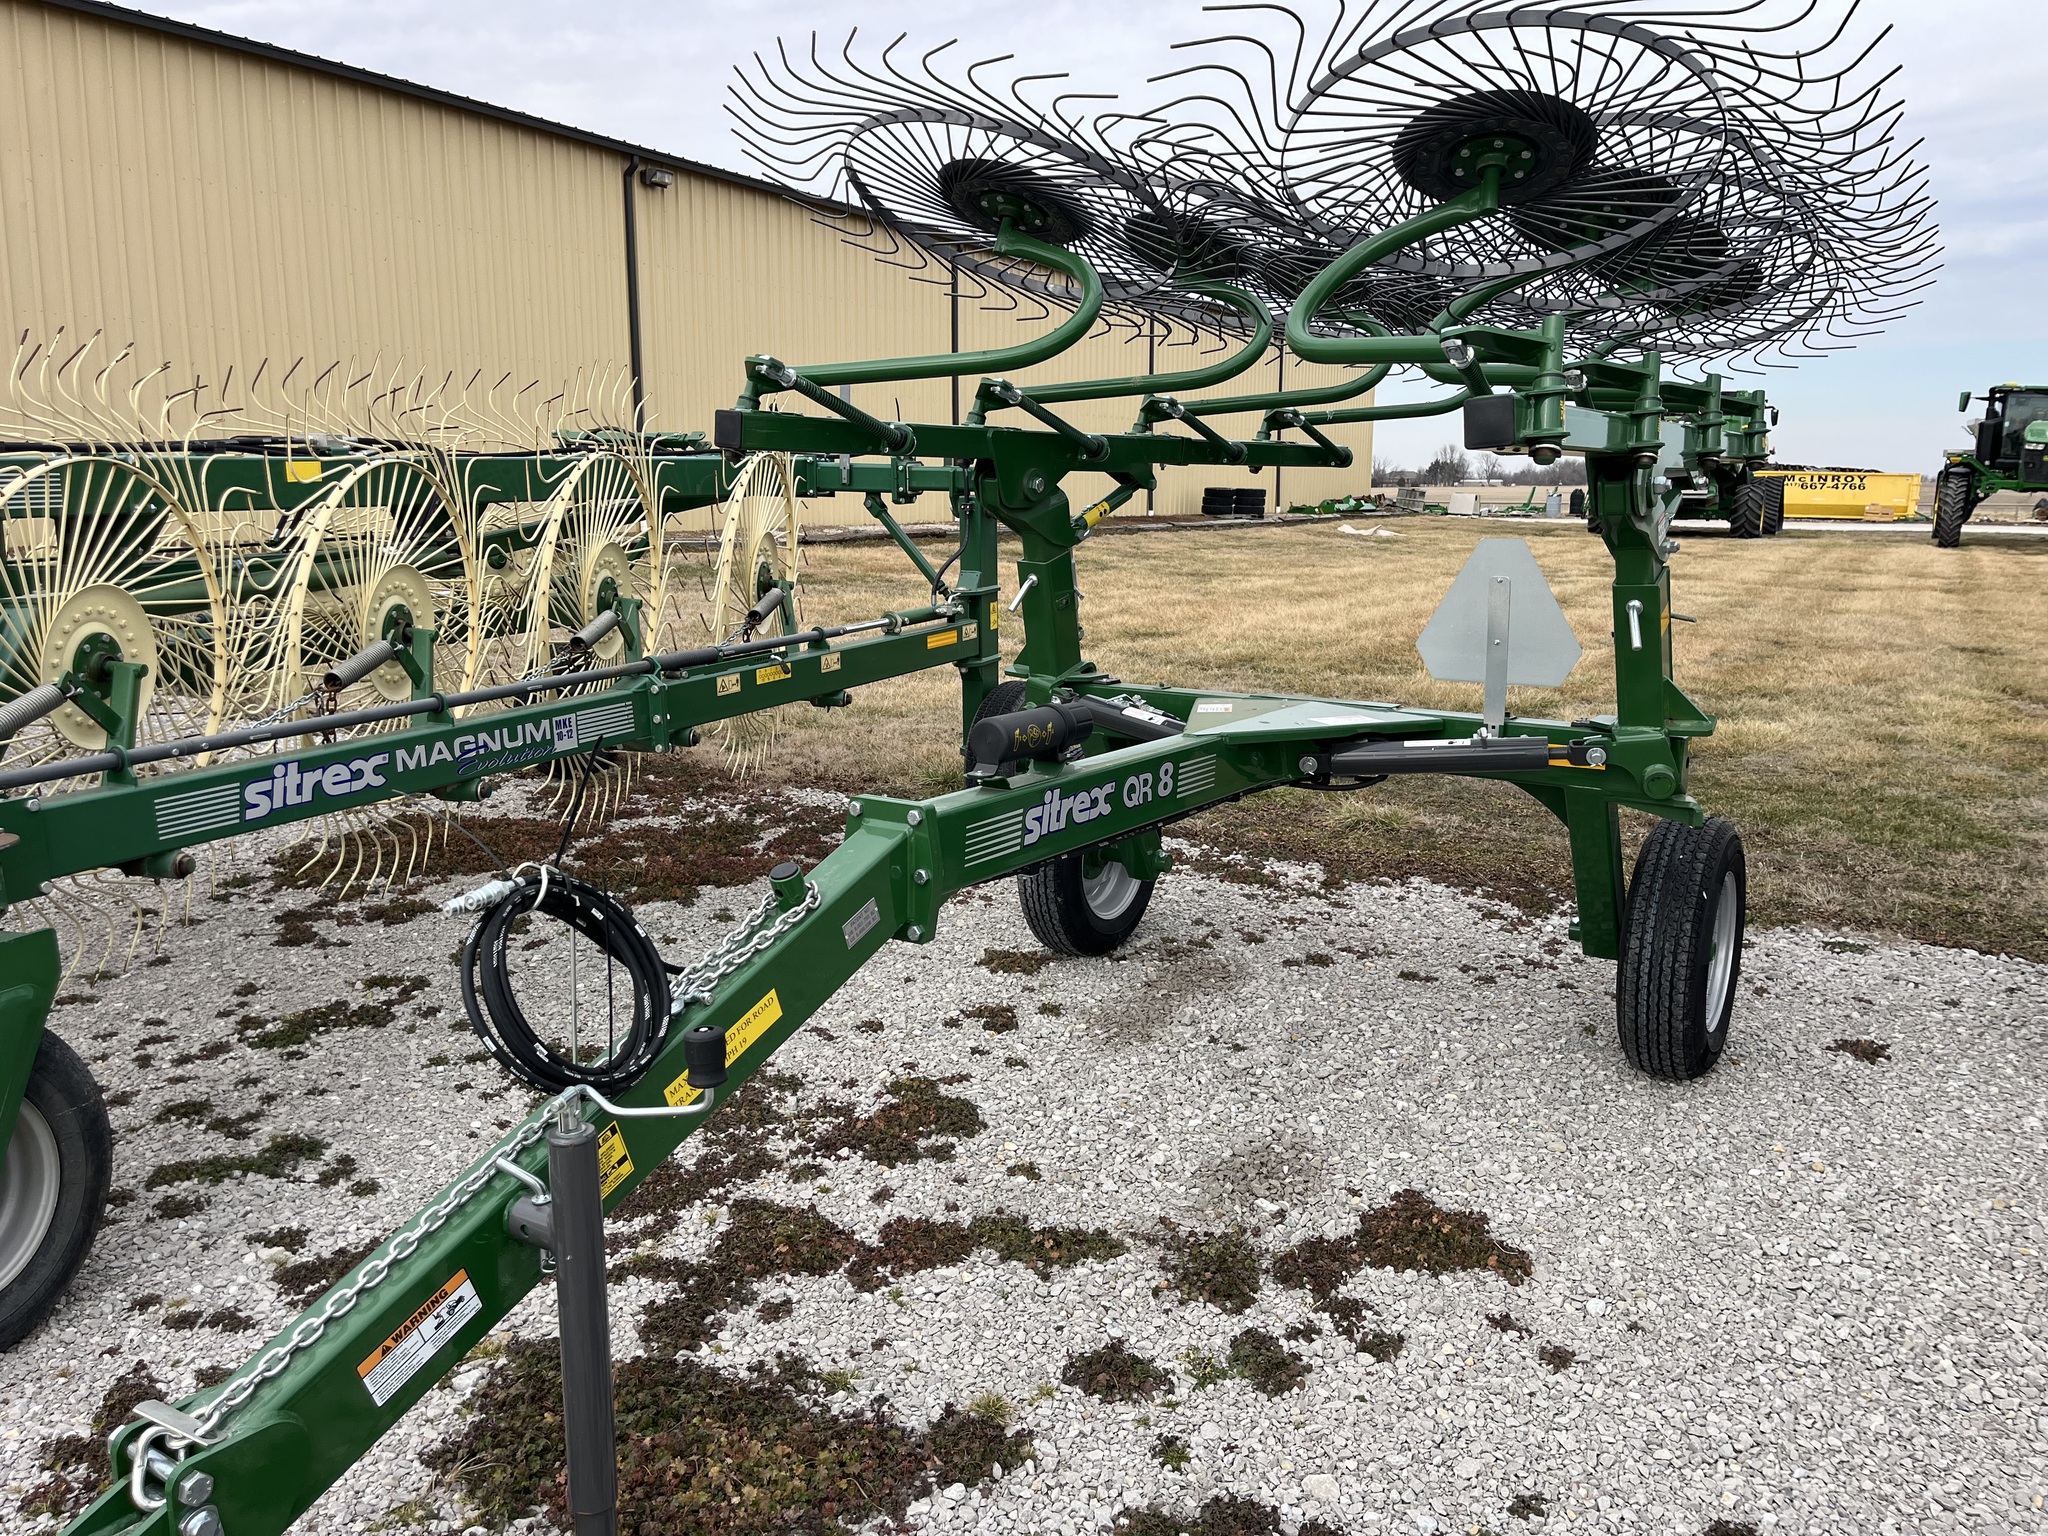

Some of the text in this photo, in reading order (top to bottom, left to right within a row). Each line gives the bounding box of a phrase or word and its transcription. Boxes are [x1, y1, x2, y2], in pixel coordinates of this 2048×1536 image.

[1800, 482, 1866, 490] 667-4766
[554, 717, 573, 731] MKE
[556, 728, 574, 742] 10-12
[243, 718, 552, 821] sitrex MAGNUM
[456, 744, 557, 776] Evolution
[1022, 761, 1174, 848] sitrex QR 8
[736, 1017, 752, 1036] FOR
[752, 996, 774, 1021] ROAD
[673, 1088, 697, 1106] TRAN
[738, 1037, 748, 1048] 19
[391, 1288, 449, 1344] WARNING
